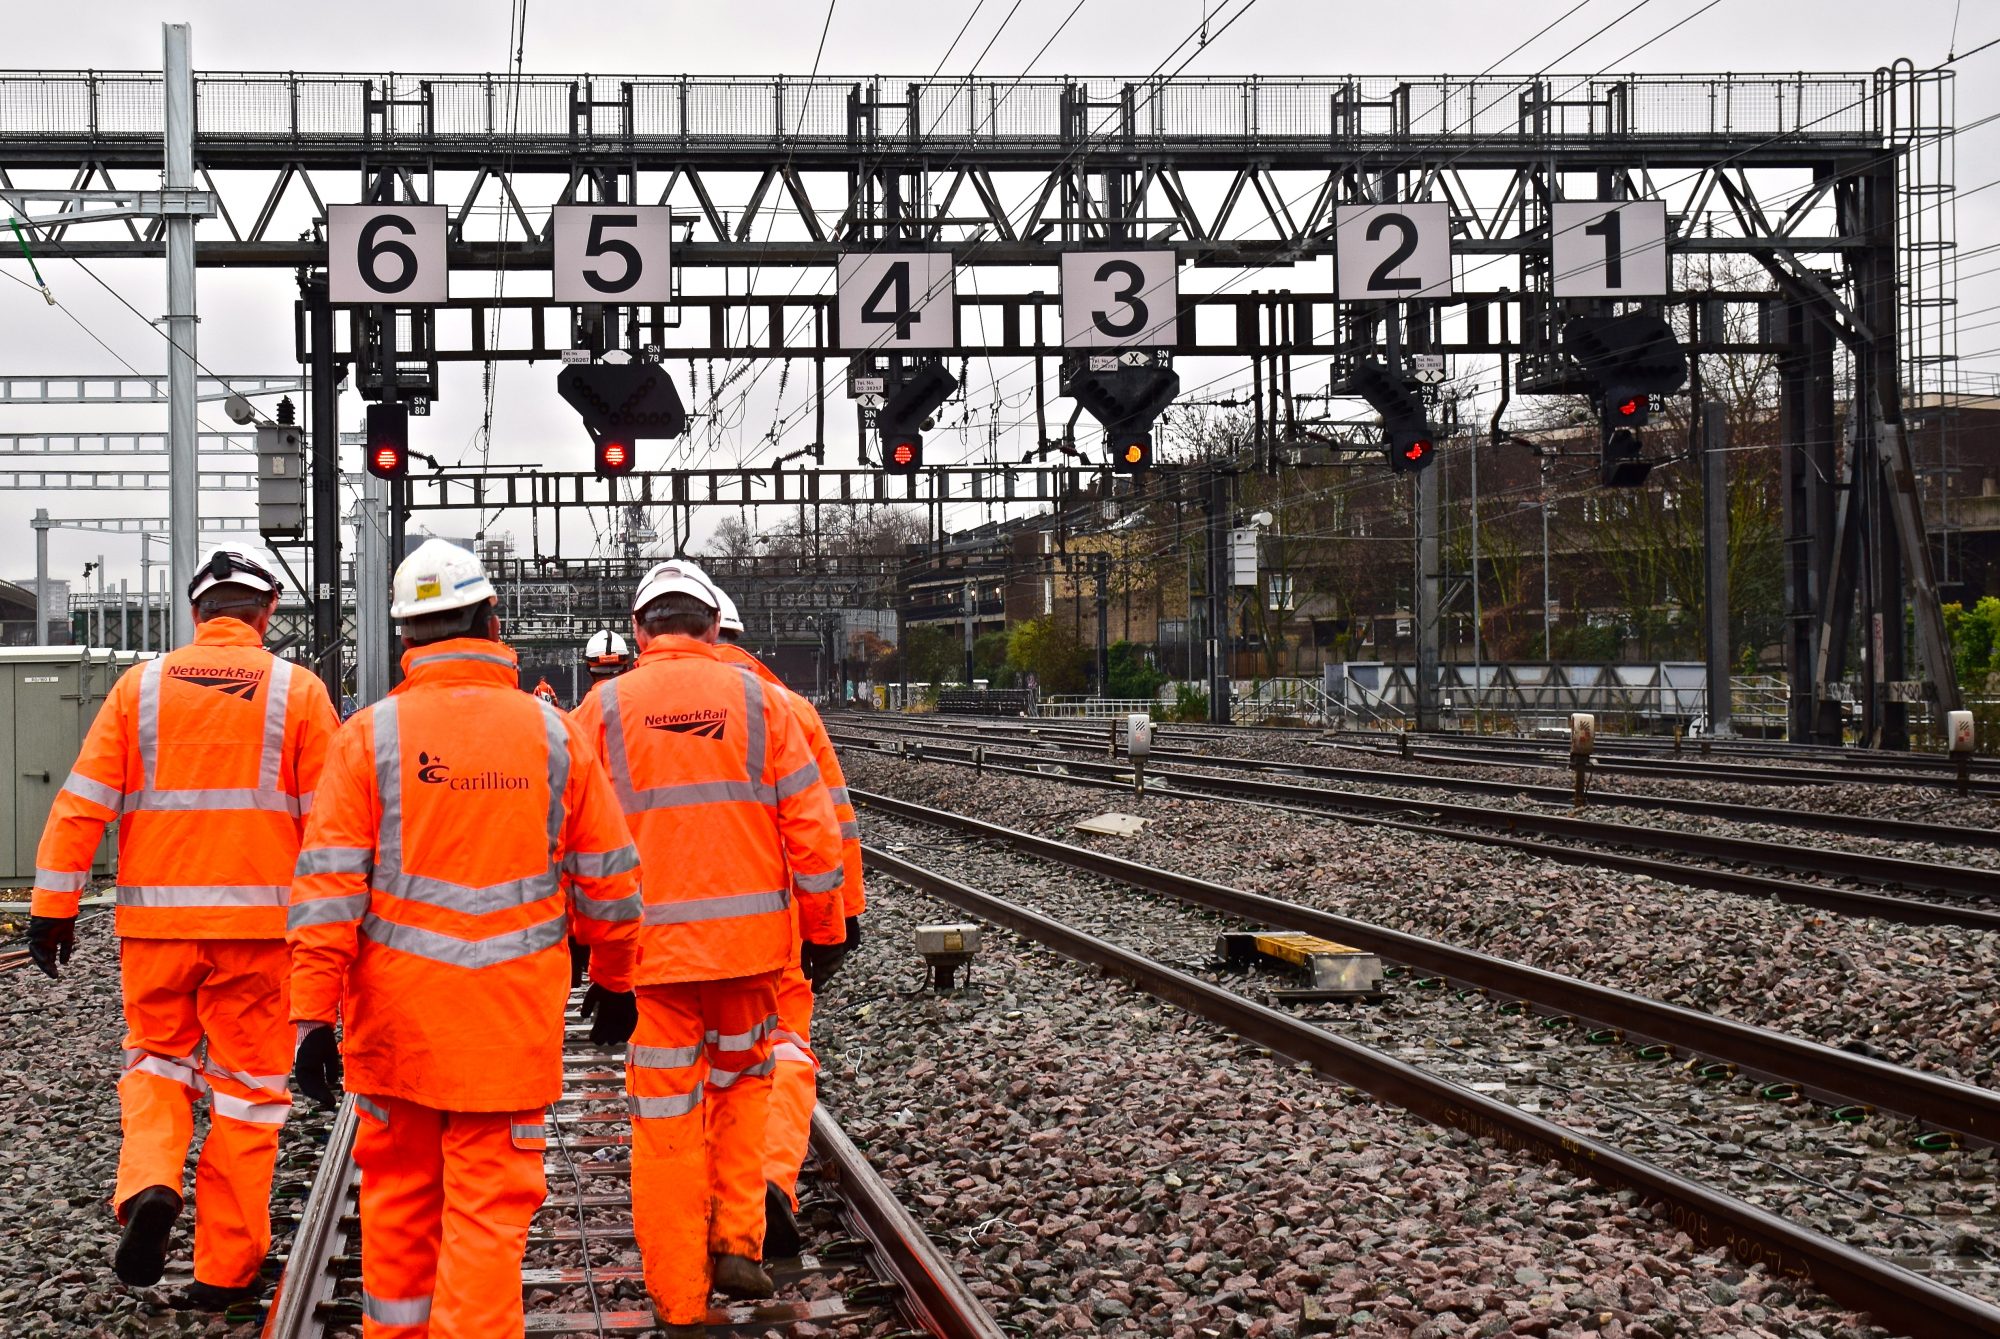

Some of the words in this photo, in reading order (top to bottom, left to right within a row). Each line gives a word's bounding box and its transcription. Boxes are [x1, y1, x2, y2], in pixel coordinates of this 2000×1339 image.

[357, 214, 418, 294] 6
[582, 214, 643, 294] 5
[1365, 212, 1422, 291] 2
[1585, 210, 1622, 289] 1
[861, 261, 921, 340] 4
[1091, 260, 1149, 338] 3
[647, 344, 660, 353] SN
[648, 354, 659, 363] 78
[1129, 353, 1139, 364] X
[1157, 350, 1169, 358] SN
[1157, 359, 1169, 368] 74
[1424, 370, 1435, 382] X
[1421, 385, 1434, 394] SN
[414, 396, 427, 405] SN
[865, 394, 875, 406] X
[1422, 395, 1433, 403] 72
[1648, 393, 1661, 402] SN
[414, 406, 426, 415] 80
[1649, 402, 1660, 411] 70
[864, 410, 877, 418] SN
[865, 419, 876, 427] 76
[450, 771, 529, 791] carillion
